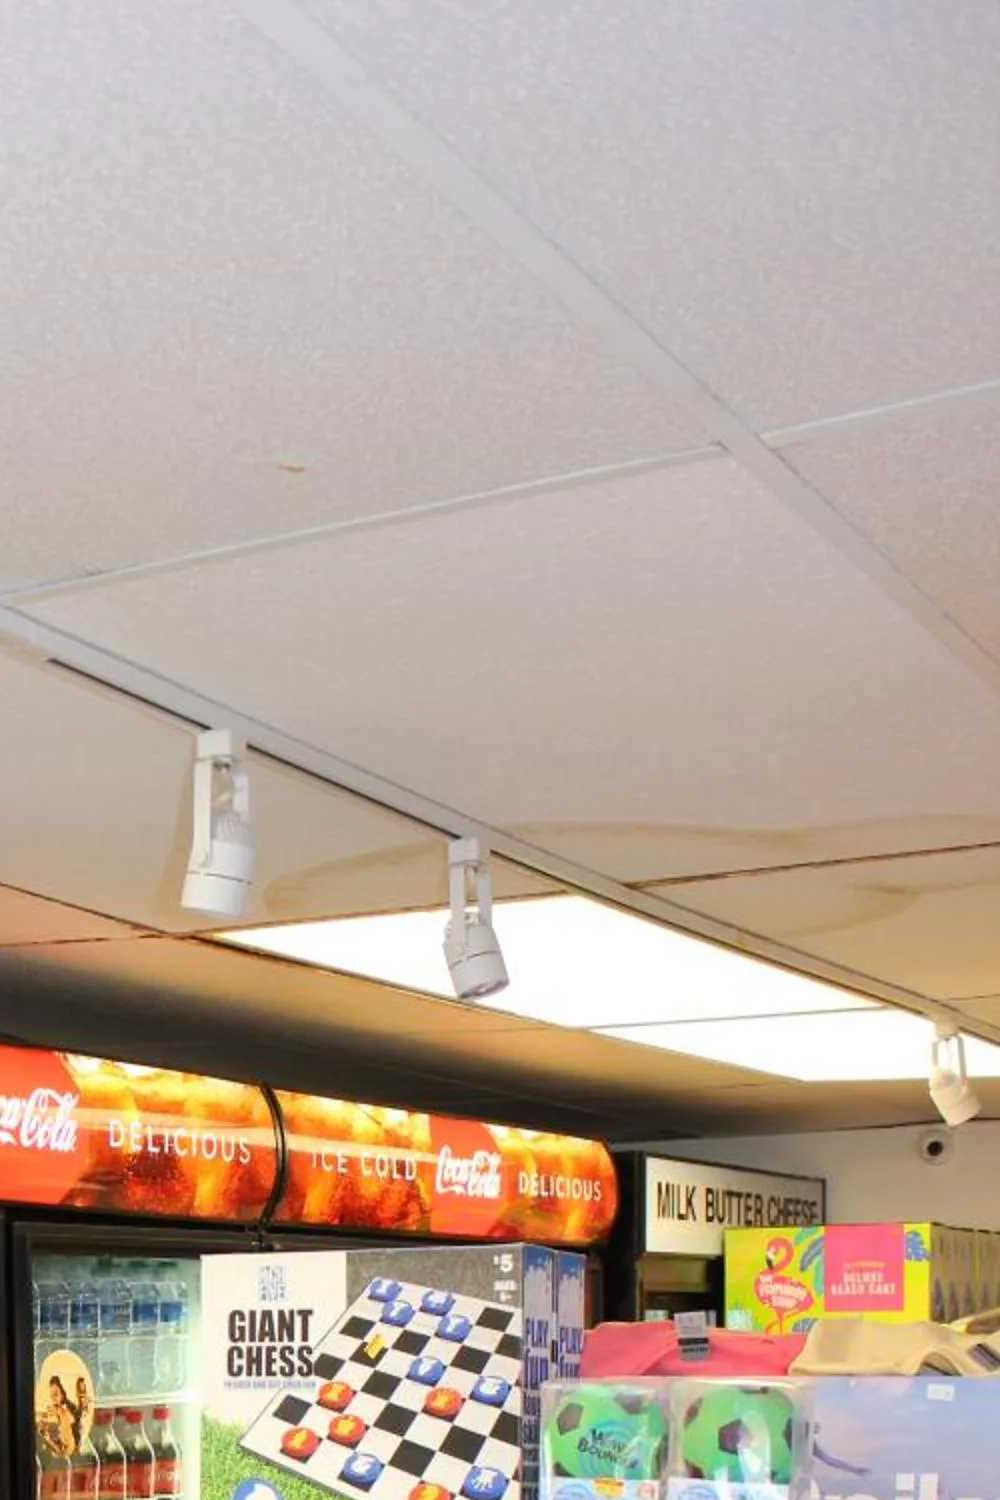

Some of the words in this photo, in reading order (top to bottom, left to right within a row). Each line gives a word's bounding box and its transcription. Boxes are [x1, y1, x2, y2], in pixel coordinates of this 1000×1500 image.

[108, 1119, 251, 1165] DELICIOUS
[311, 1149, 349, 1174] ICE
[360, 1152, 418, 1181] COLD
[518, 1171, 602, 1201] DELICIOUS
[656, 1182, 696, 1221] MILK
[705, 1188, 764, 1226] BUTTER
[767, 1197, 818, 1226] CHEESE
[228, 1309, 313, 1343] GIANT
[227, 1344, 315, 1378] CHESS
